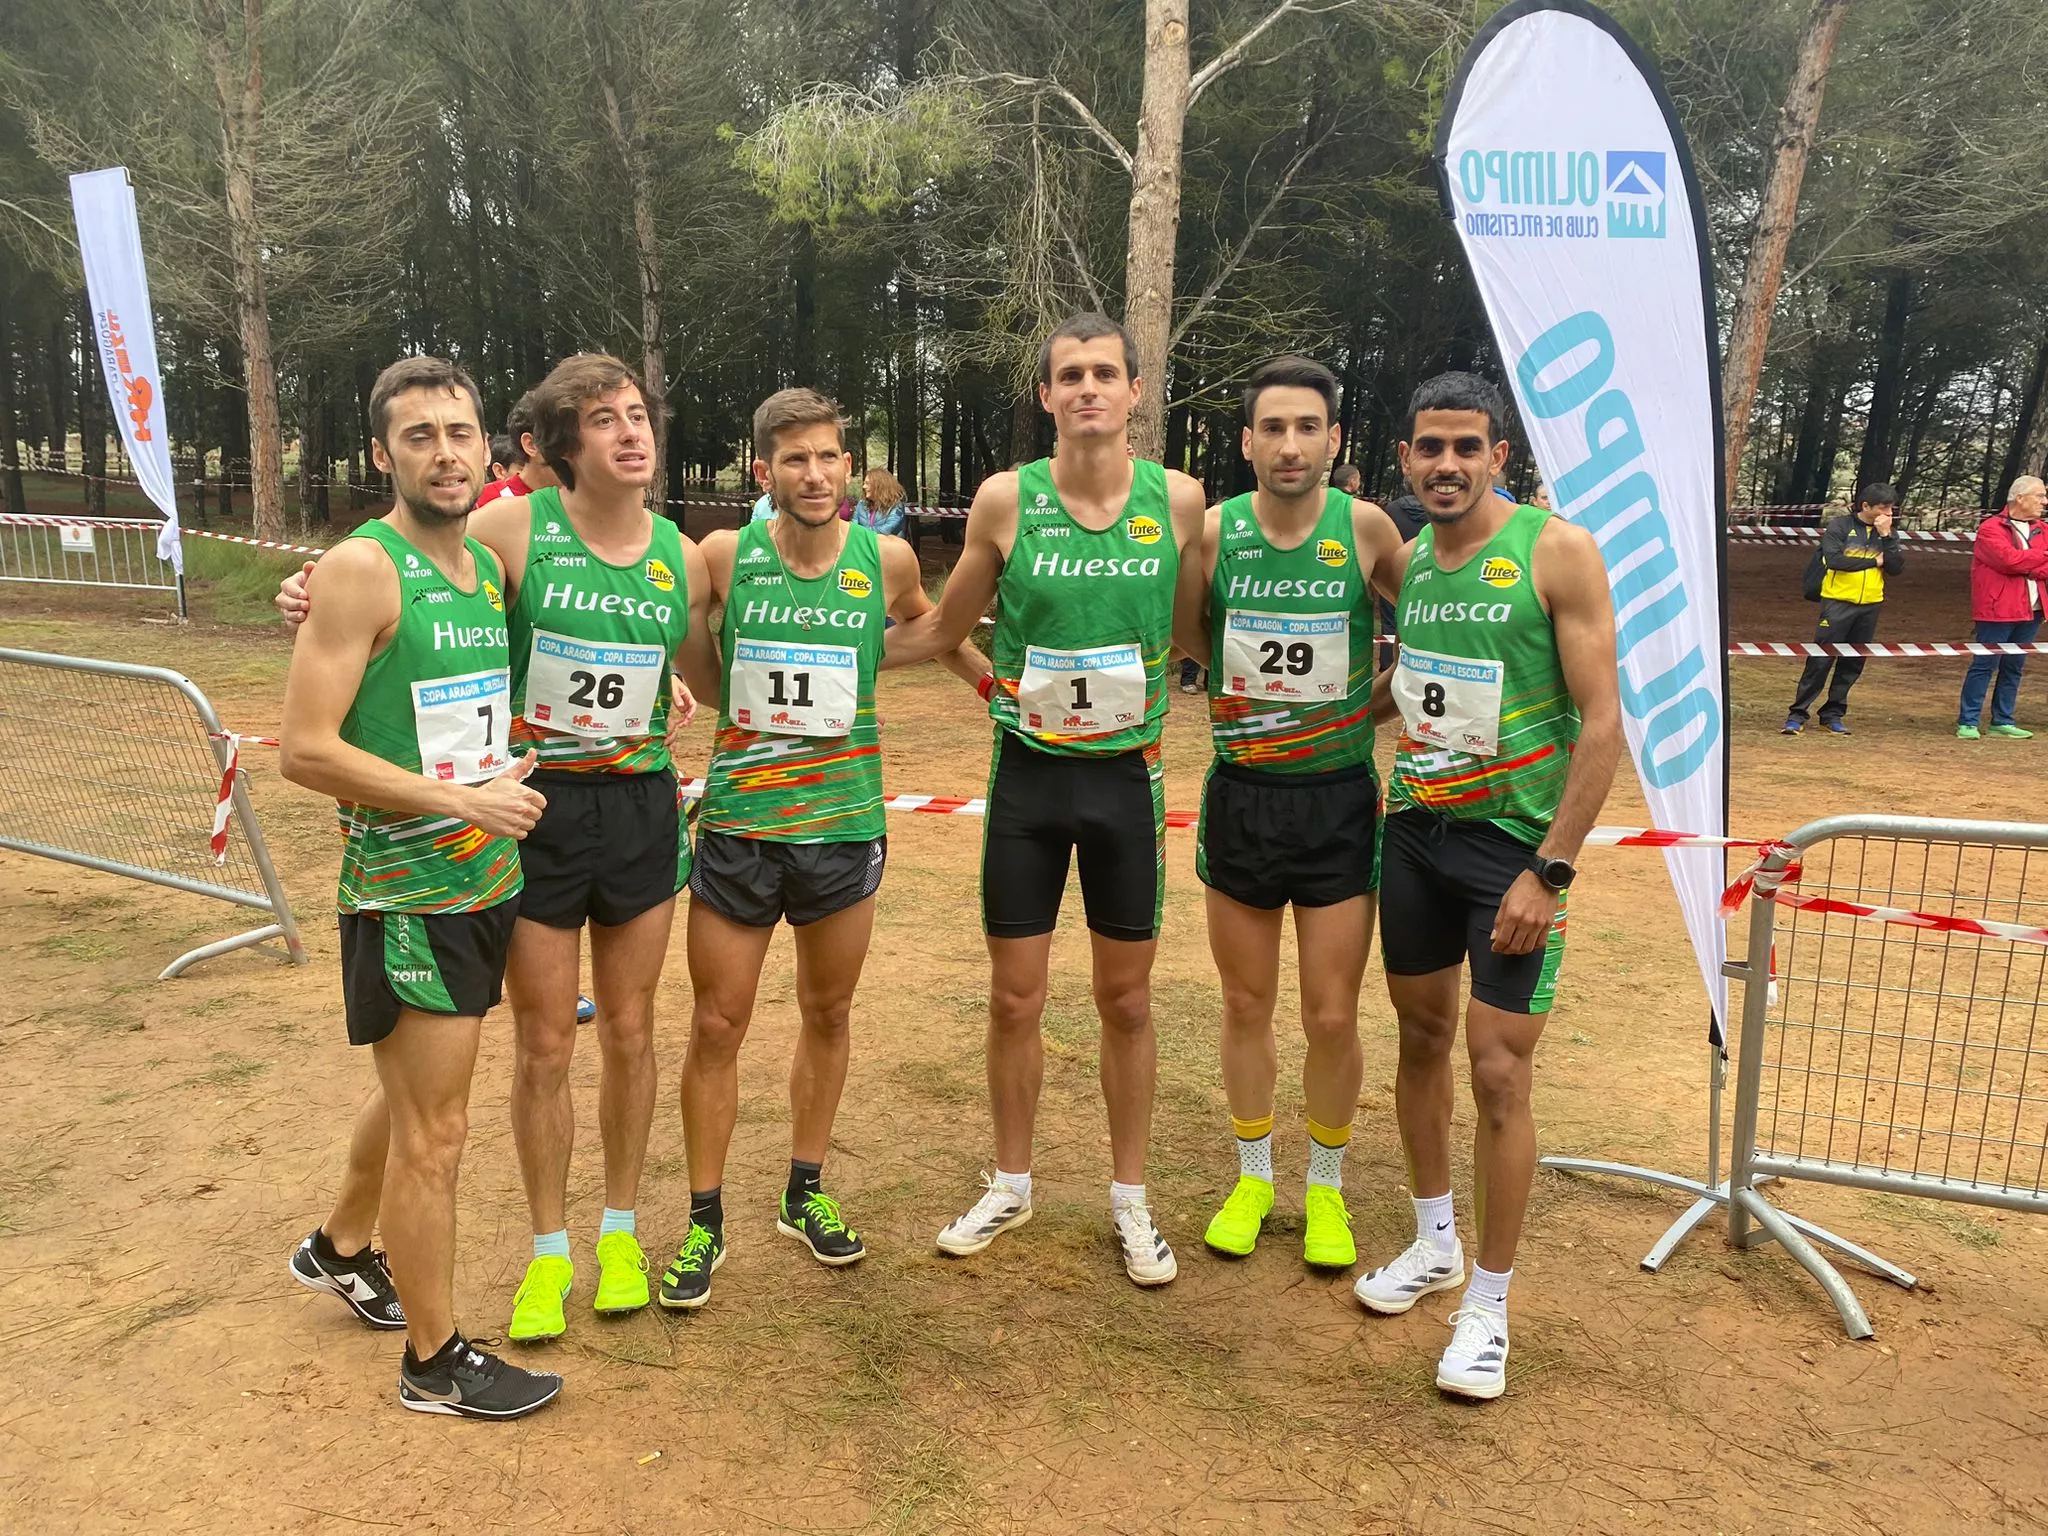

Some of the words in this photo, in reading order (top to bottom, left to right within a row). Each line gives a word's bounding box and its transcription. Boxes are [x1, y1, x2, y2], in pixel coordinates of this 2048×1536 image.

[534, 534, 571, 543] VIATOR
[1041, 528, 1070, 537] ZOITI
[1226, 531, 1253, 540] VIATOR
[552, 557, 587, 567] ZOITI
[738, 556, 770, 564] VIATOR
[1238, 549, 1262, 560] ZOITI
[1032, 552, 1160, 577] Huesca
[754, 576, 782, 585] ZOITI
[1228, 575, 1345, 598] Huesca
[427, 591, 453, 603] ZOITI
[542, 583, 672, 624] Huesca
[742, 600, 867, 628] Huesca
[1404, 600, 1512, 626] Huesca
[1232, 618, 1251, 628] COPA
[1290, 624, 1309, 633] COPA
[1312, 622, 1343, 632] ESCOLAR
[540, 640, 561, 654] COPA
[603, 652, 623, 664] COPA
[625, 654, 657, 664] ESCOLAR
[739, 648, 754, 658] COPA
[794, 654, 815, 663] COPA
[816, 655, 851, 665] ESCOLAR
[1032, 655, 1046, 667] COPA
[1083, 659, 1101, 668] COPA
[1103, 653, 1133, 665] ESCOLAR
[1260, 641, 1314, 676] 29
[1439, 663, 1456, 676] COPA
[1458, 667, 1493, 680] ESCOLAR
[424, 688, 448, 702] COPA
[568, 670, 625, 710] 26
[768, 671, 813, 707] 11
[1071, 678, 1092, 709] 1
[1422, 682, 1445, 717] 8
[477, 704, 493, 746] 7
[392, 970, 433, 982] ZOITI
